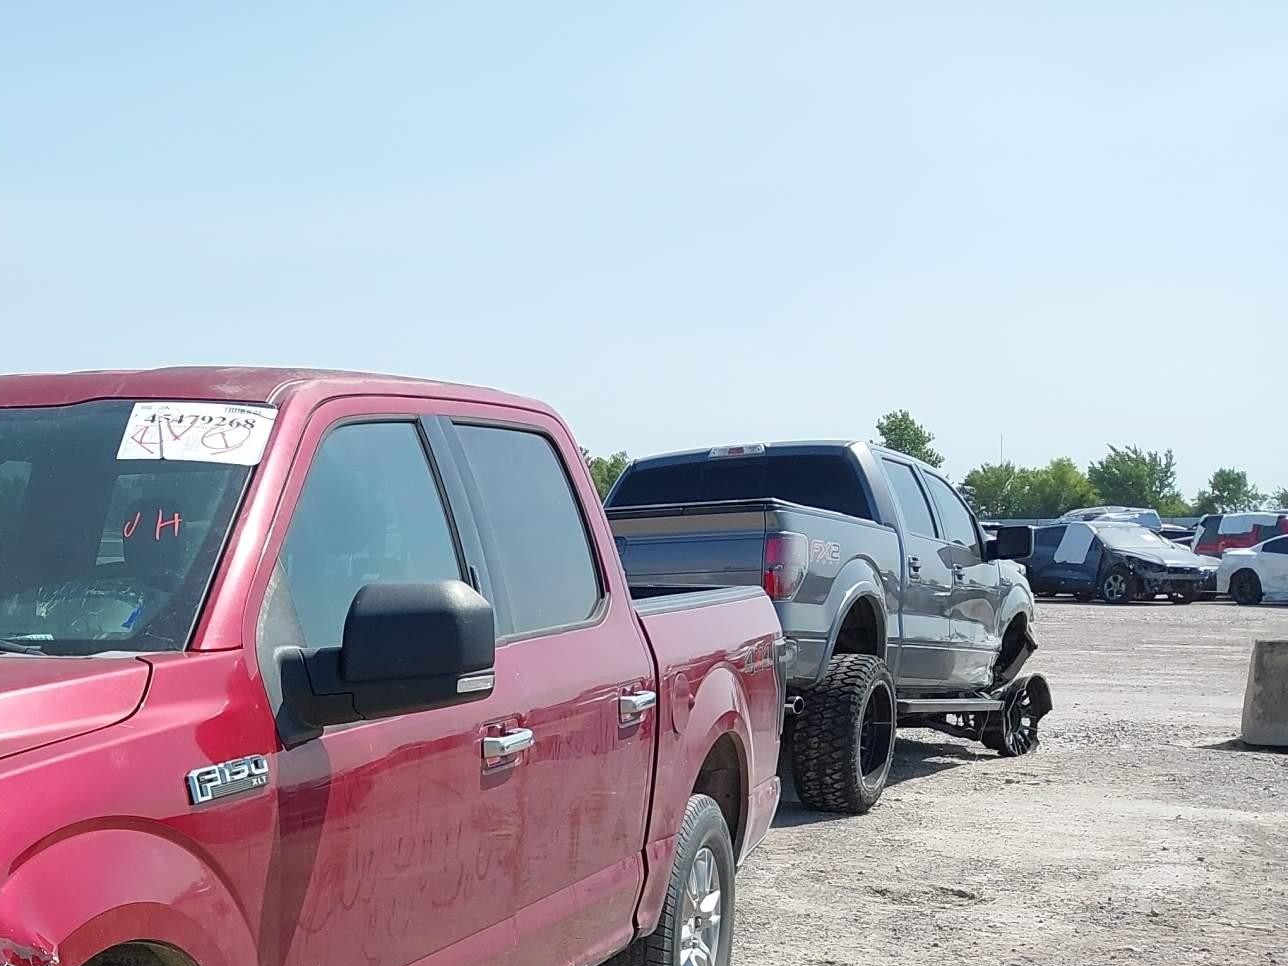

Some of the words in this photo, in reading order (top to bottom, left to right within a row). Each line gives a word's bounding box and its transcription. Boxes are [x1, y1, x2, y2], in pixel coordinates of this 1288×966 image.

[144, 413, 257, 429] 45479268
[810, 539, 841, 561] FX2
[252, 776, 268, 787] XLT
